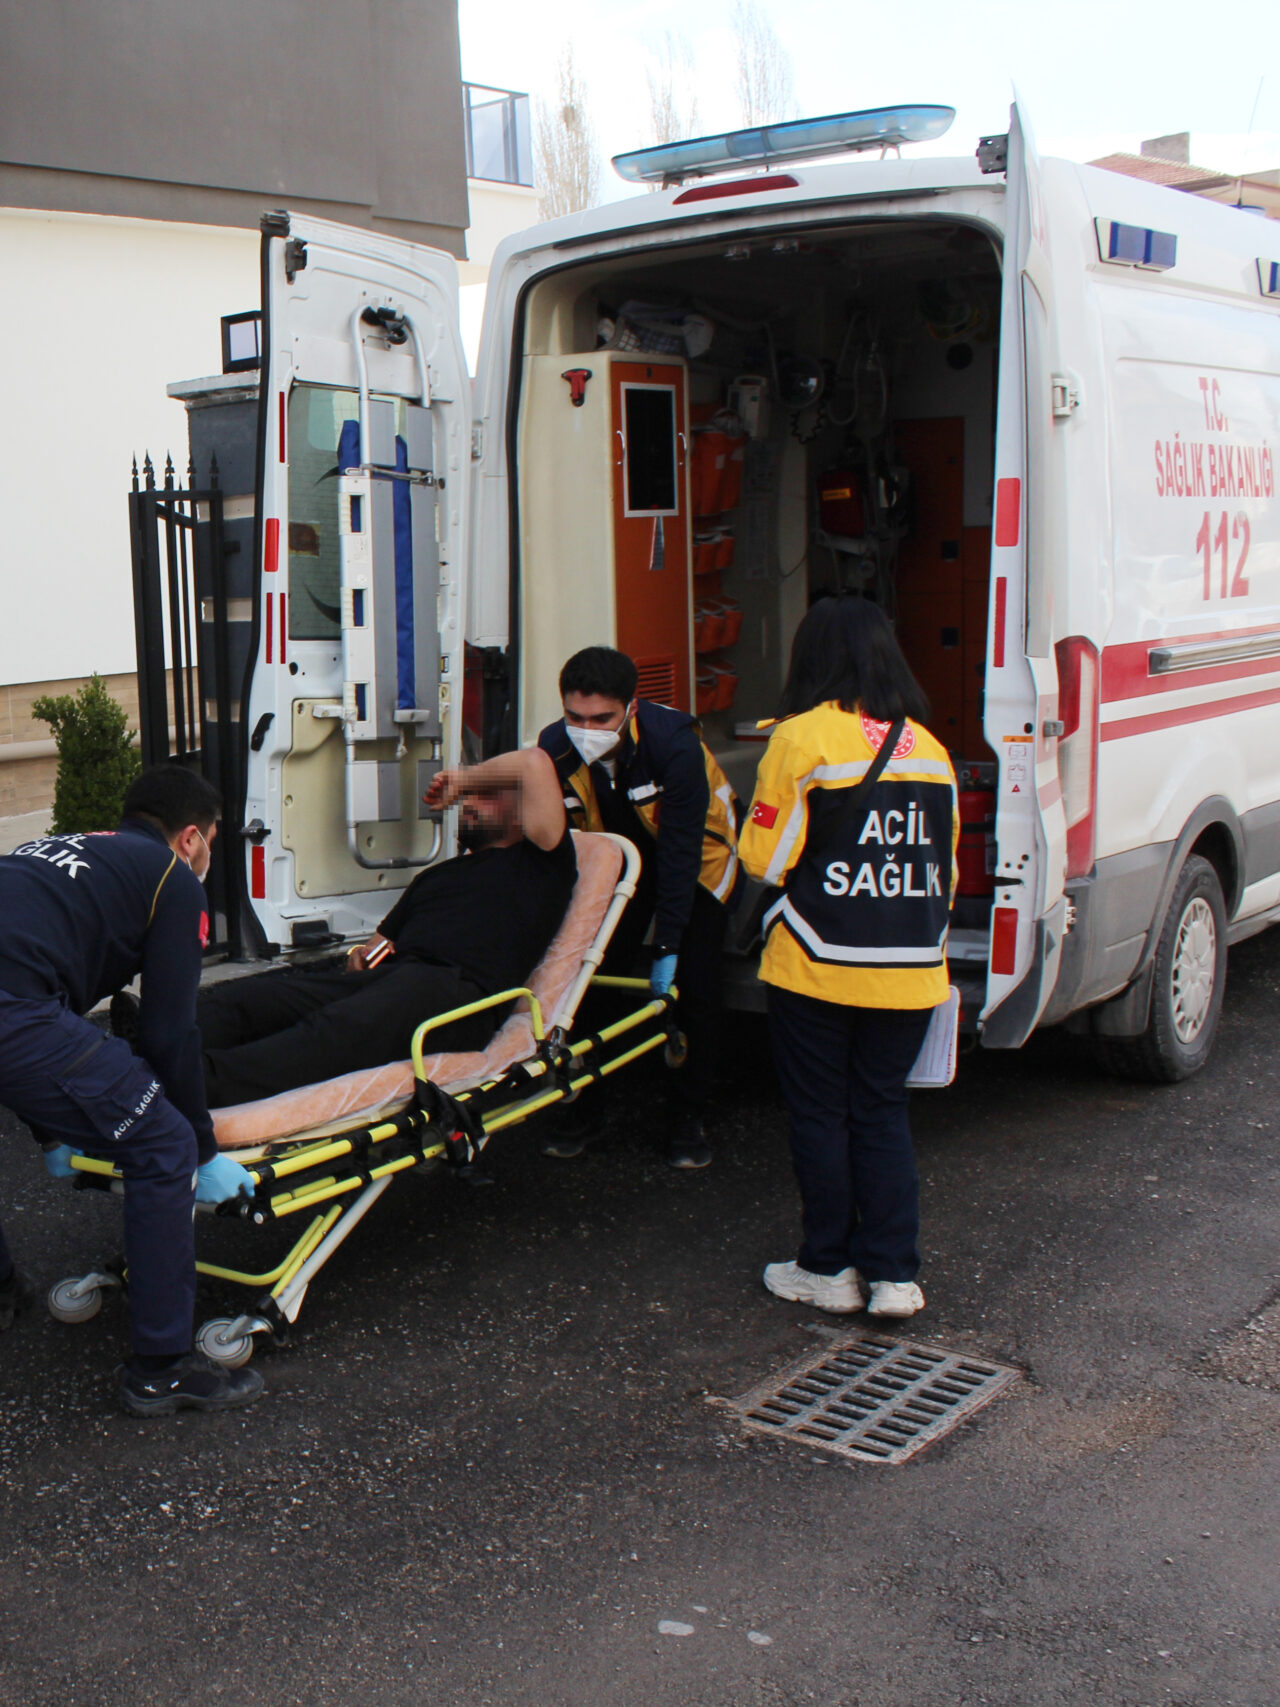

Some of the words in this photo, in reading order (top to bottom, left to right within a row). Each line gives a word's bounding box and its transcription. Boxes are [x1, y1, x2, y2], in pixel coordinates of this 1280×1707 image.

[1155, 430, 1206, 498] SAĞLIK
[1208, 438, 1274, 498] BAKANLIĞI
[1196, 510, 1250, 601] 112
[857, 802, 932, 845] ACİL
